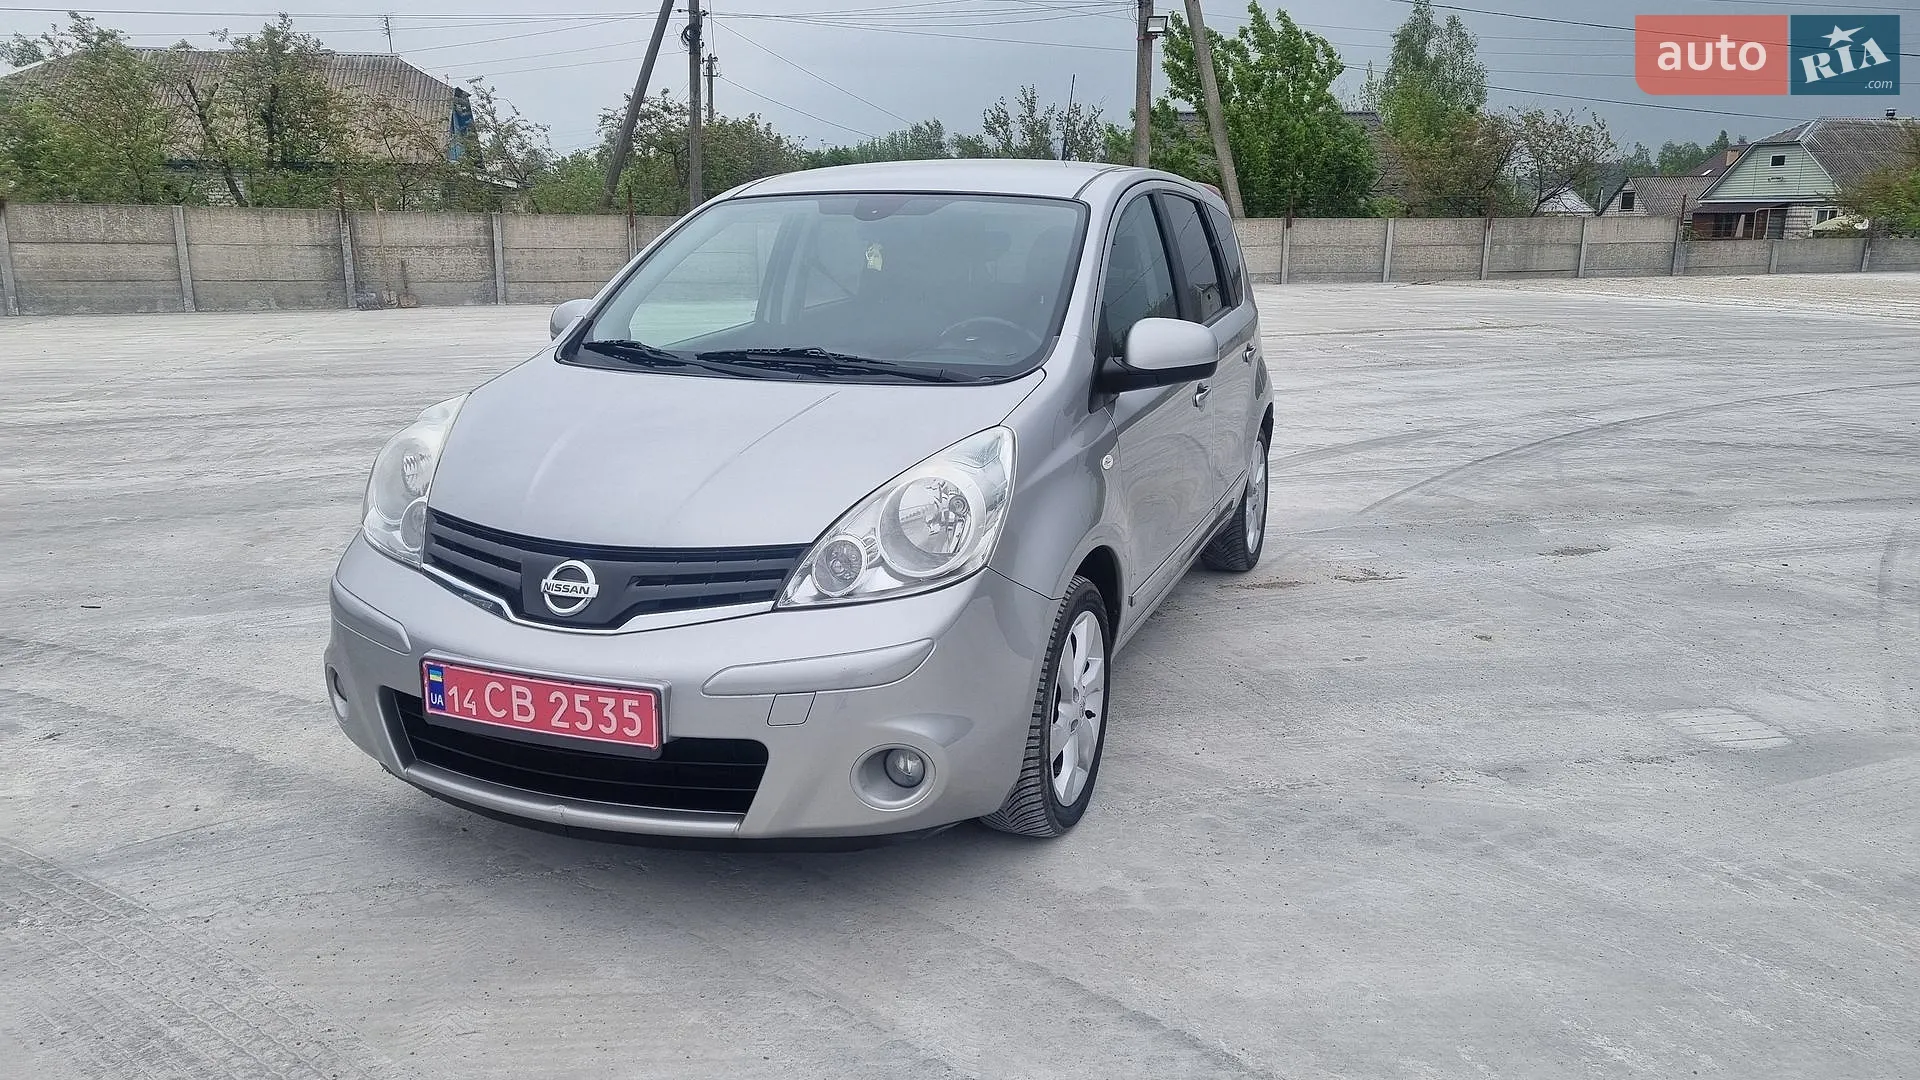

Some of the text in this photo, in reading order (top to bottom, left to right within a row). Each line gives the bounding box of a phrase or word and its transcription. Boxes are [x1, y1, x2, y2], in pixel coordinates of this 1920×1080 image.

[543, 582, 590, 595] NISSAN
[430, 693, 444, 707] UA
[548, 690, 643, 737] 2535
